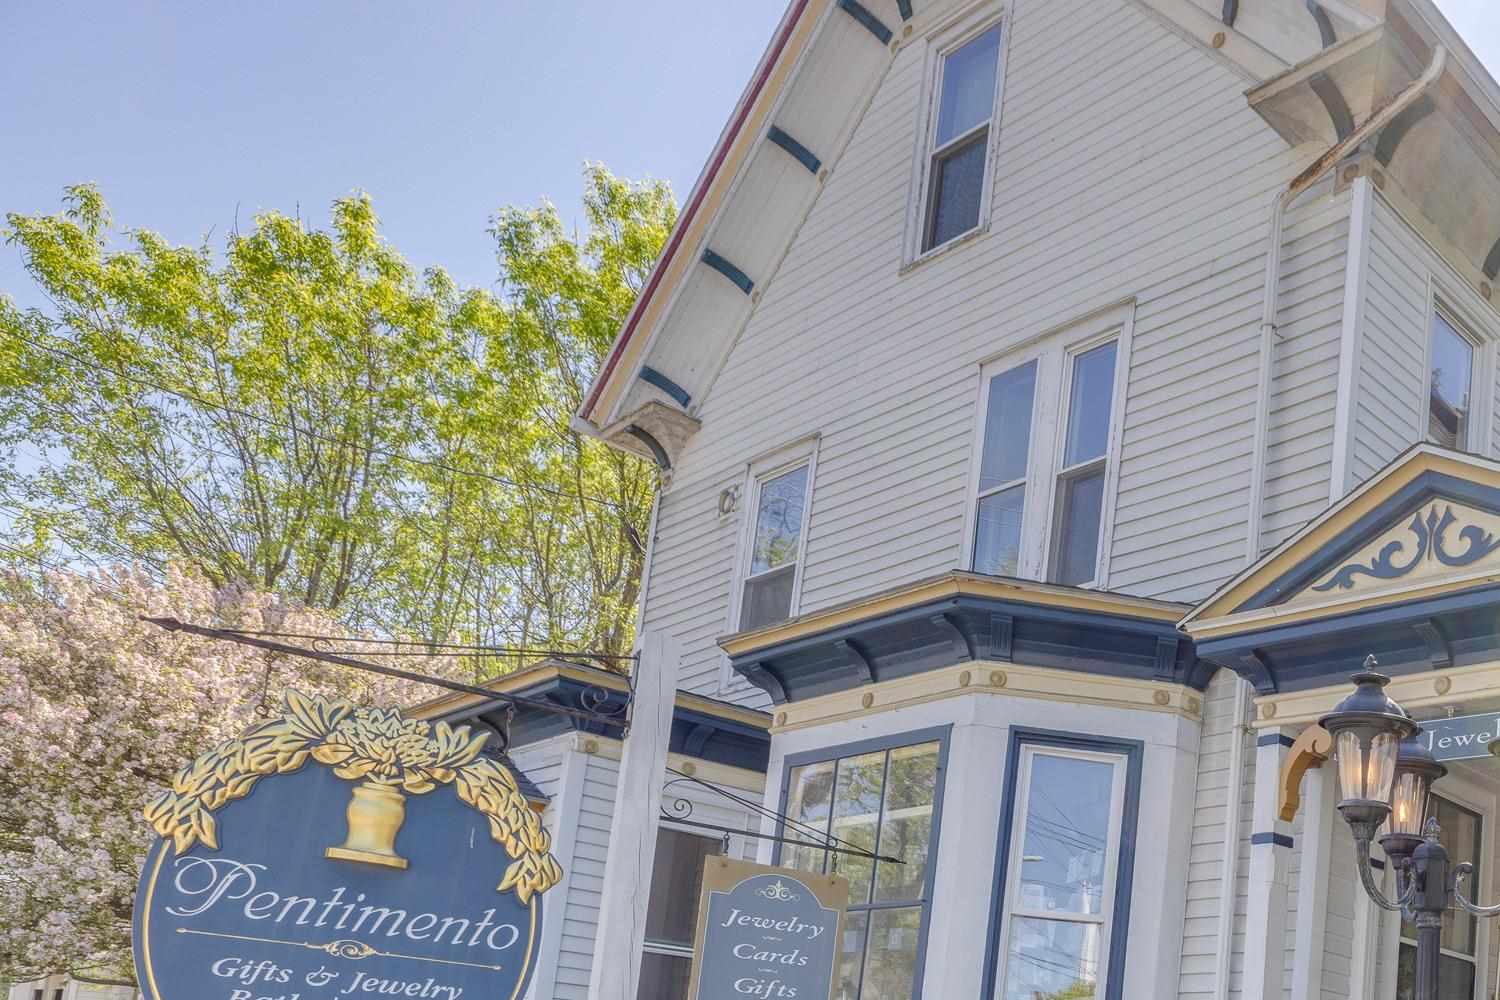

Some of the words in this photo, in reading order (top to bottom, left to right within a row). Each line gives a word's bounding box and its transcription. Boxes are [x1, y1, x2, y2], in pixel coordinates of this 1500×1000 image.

[165, 856, 519, 950] Pentimento
[721, 908, 825, 940] Jewelry
[732, 943, 809, 967] Cards
[211, 957, 294, 985] Gifts
[305, 966, 339, 986] &
[734, 978, 798, 999] Gifts
